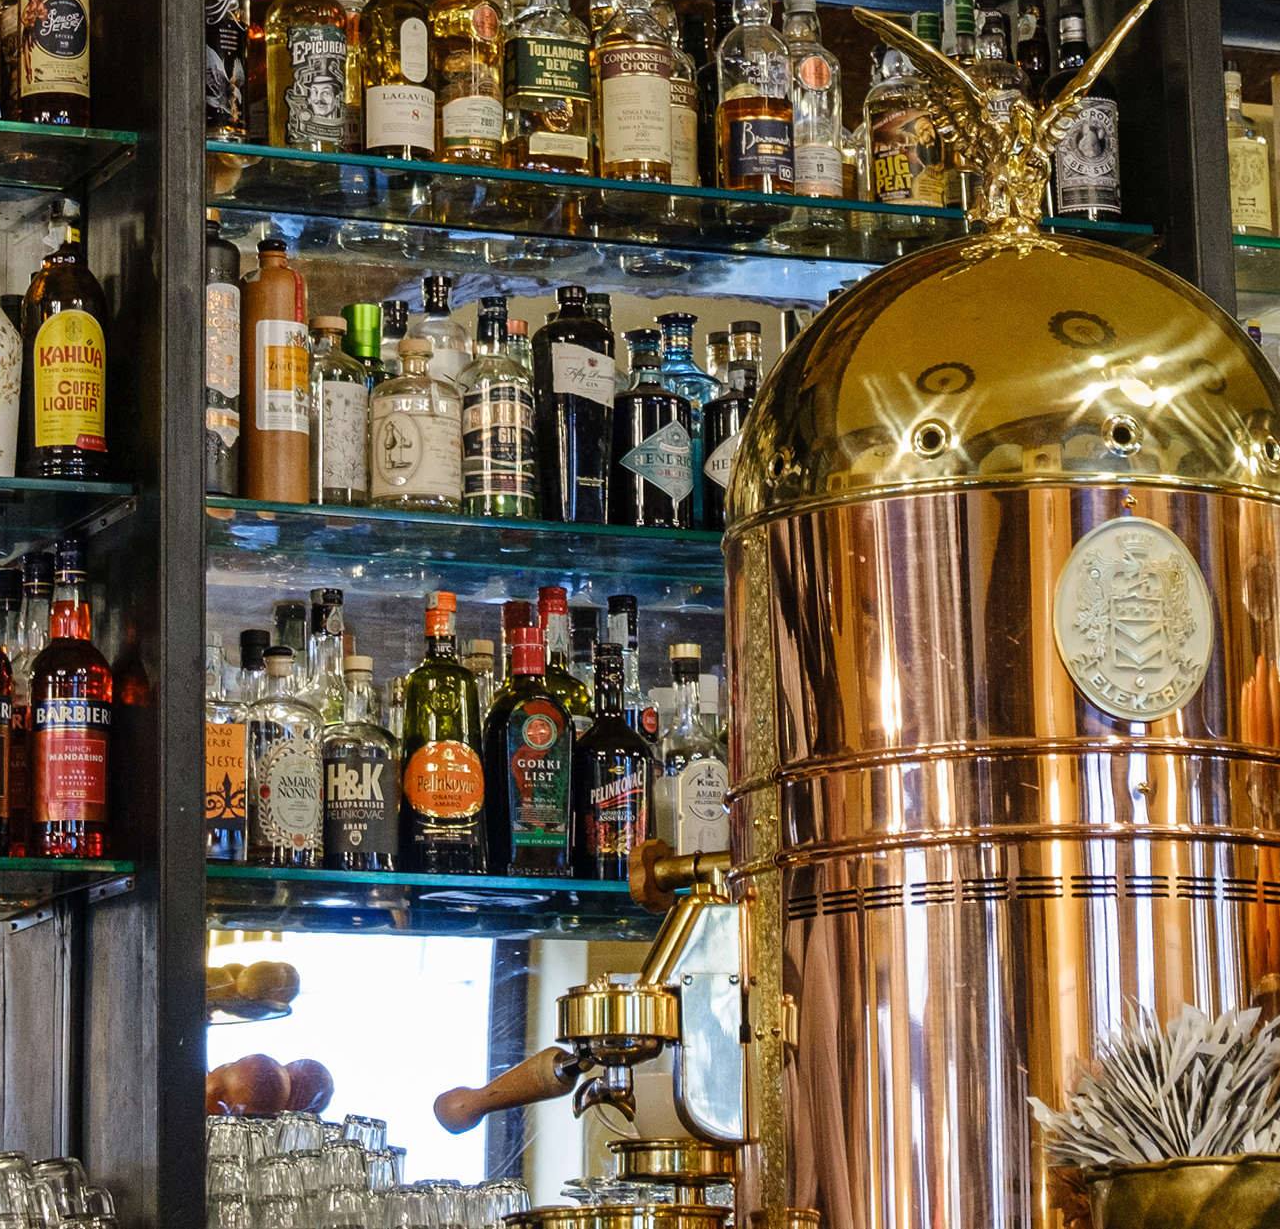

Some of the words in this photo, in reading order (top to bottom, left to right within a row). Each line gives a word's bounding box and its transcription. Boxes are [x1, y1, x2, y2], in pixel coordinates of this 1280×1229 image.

[526, 40, 586, 62] TULLAMORE
[546, 57, 570, 72] DEW
[620, 61, 660, 72] CHOICE
[382, 91, 435, 105] LAGAVULI
[670, 95, 688, 104] OICE
[411, 108, 420, 120] 8
[816, 163, 825, 173] 13
[875, 153, 910, 179] BIG
[781, 168, 791, 179] 10
[876, 173, 914, 194] PEAT
[62, 367, 100, 376] ORIGINAL
[565, 366, 586, 384] Fifty
[57, 380, 101, 398] COFFEE
[43, 395, 98, 413] LIQUEUR
[634, 453, 692, 469] HENDRIC
[1089, 672, 1191, 710] ELEKTRA
[206, 726, 233, 737] ARO
[64, 745, 92, 753] PUNCH
[49, 753, 104, 763] MANDARINO
[517, 758, 562, 770] GORKI
[280, 775, 317, 788] AMARO
[327, 762, 384, 801] H&K
[524, 772, 555, 782] LIST
[697, 778, 720, 788] KNEZ
[277, 787, 317, 800] NONINO
[590, 770, 645, 805] PELINKOVAC
[432, 794, 463, 802] ORANGE
[695, 790, 722, 799] AMARO
[326, 809, 385, 820] PELINKOVAC
[343, 823, 368, 831] AMARO
